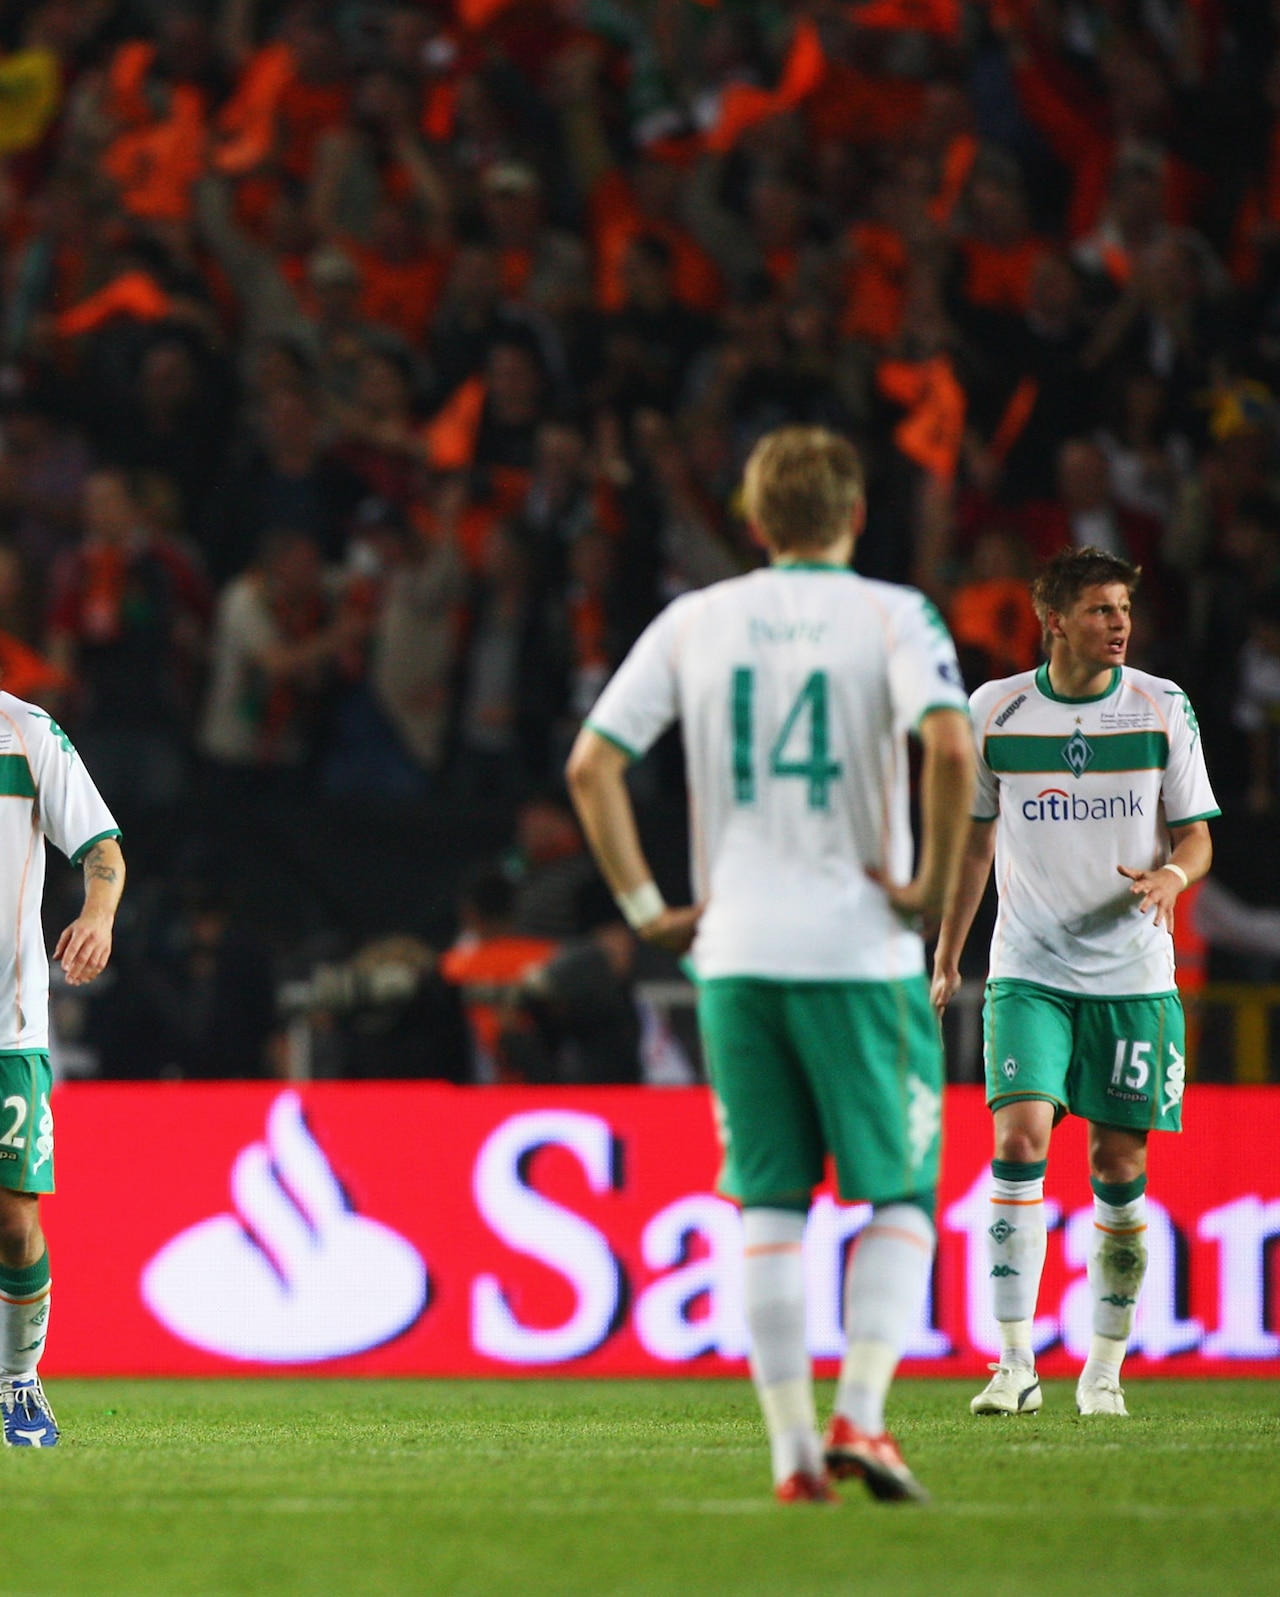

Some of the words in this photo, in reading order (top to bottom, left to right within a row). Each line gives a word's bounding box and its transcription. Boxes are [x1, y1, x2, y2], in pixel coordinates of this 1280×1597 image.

[731, 666, 842, 809] 14
[1022, 789, 1144, 821] citibank
[1111, 1038, 1152, 1089] 15
[1106, 1086, 1148, 1102] Kappa
